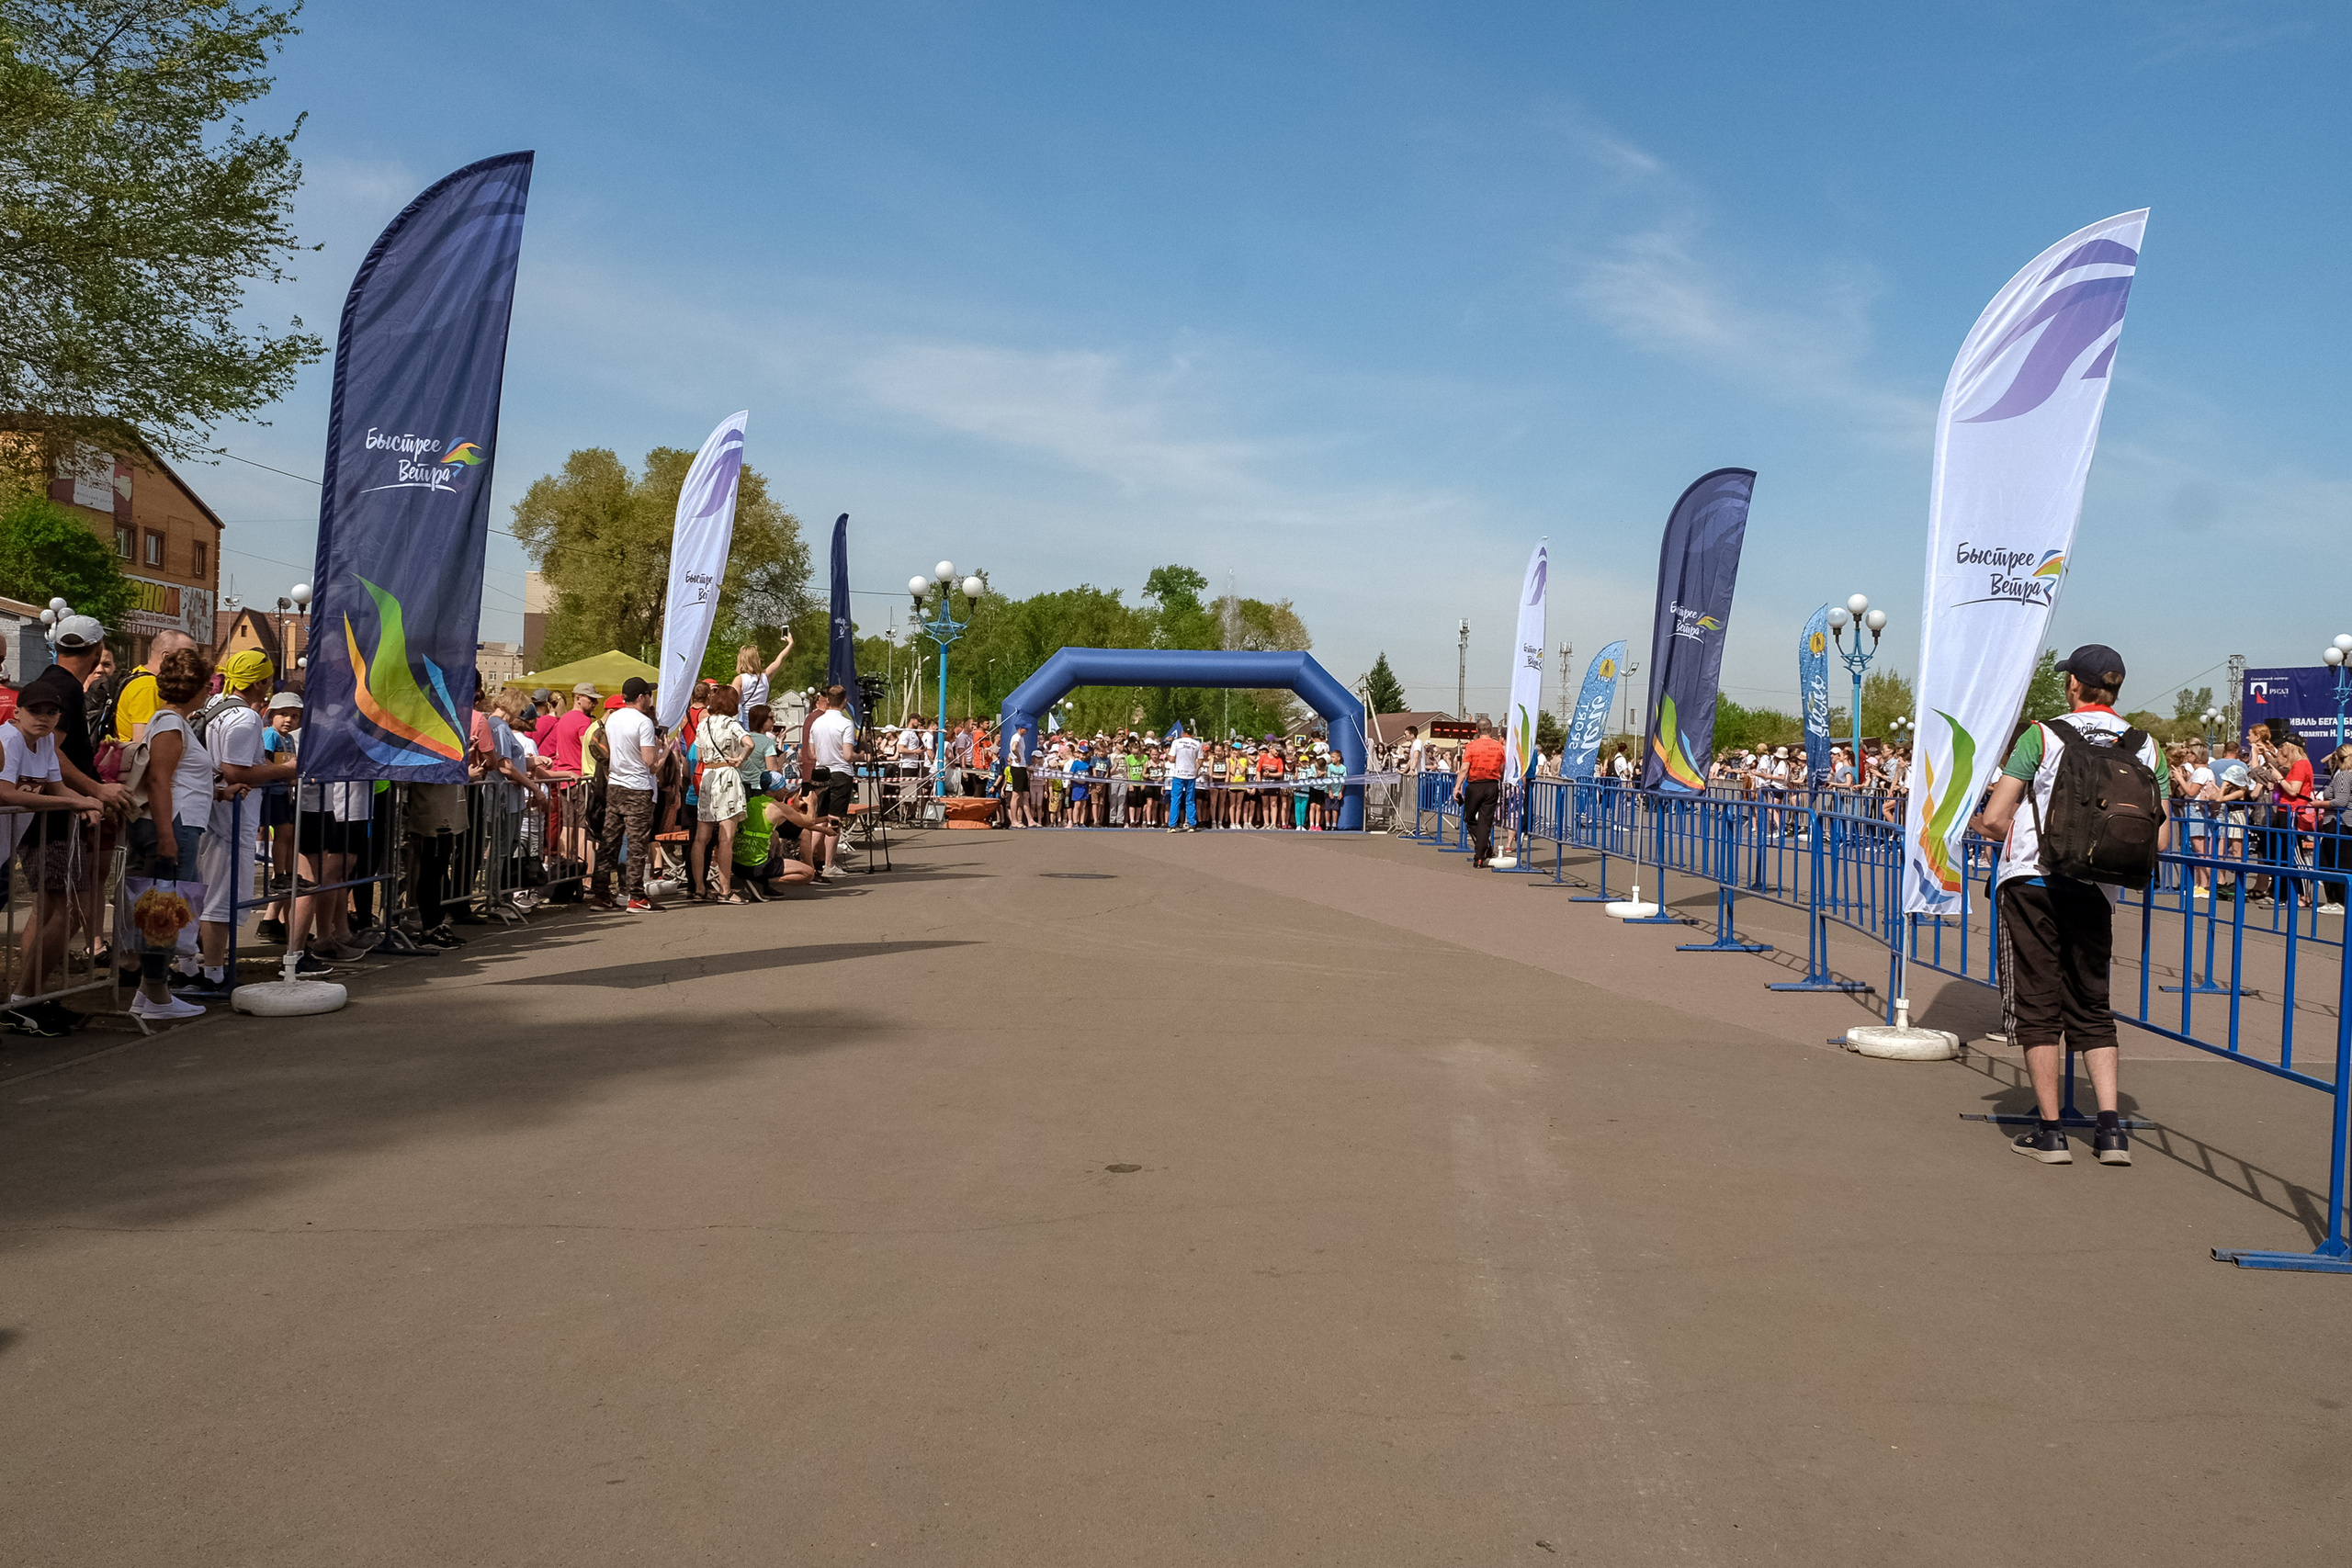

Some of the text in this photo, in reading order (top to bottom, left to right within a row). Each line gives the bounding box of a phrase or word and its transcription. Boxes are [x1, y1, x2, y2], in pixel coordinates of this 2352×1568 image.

[365, 427, 442, 462] Быстрее
[398, 459, 451, 491] Ветра
[1956, 542, 2035, 576] Быстрее
[1989, 573, 2041, 606] Ветра
[1676, 619, 1700, 639] Ветра
[2290, 717, 2317, 726] ИВАЛЬ
[2318, 717, 2338, 726] БЕГА
